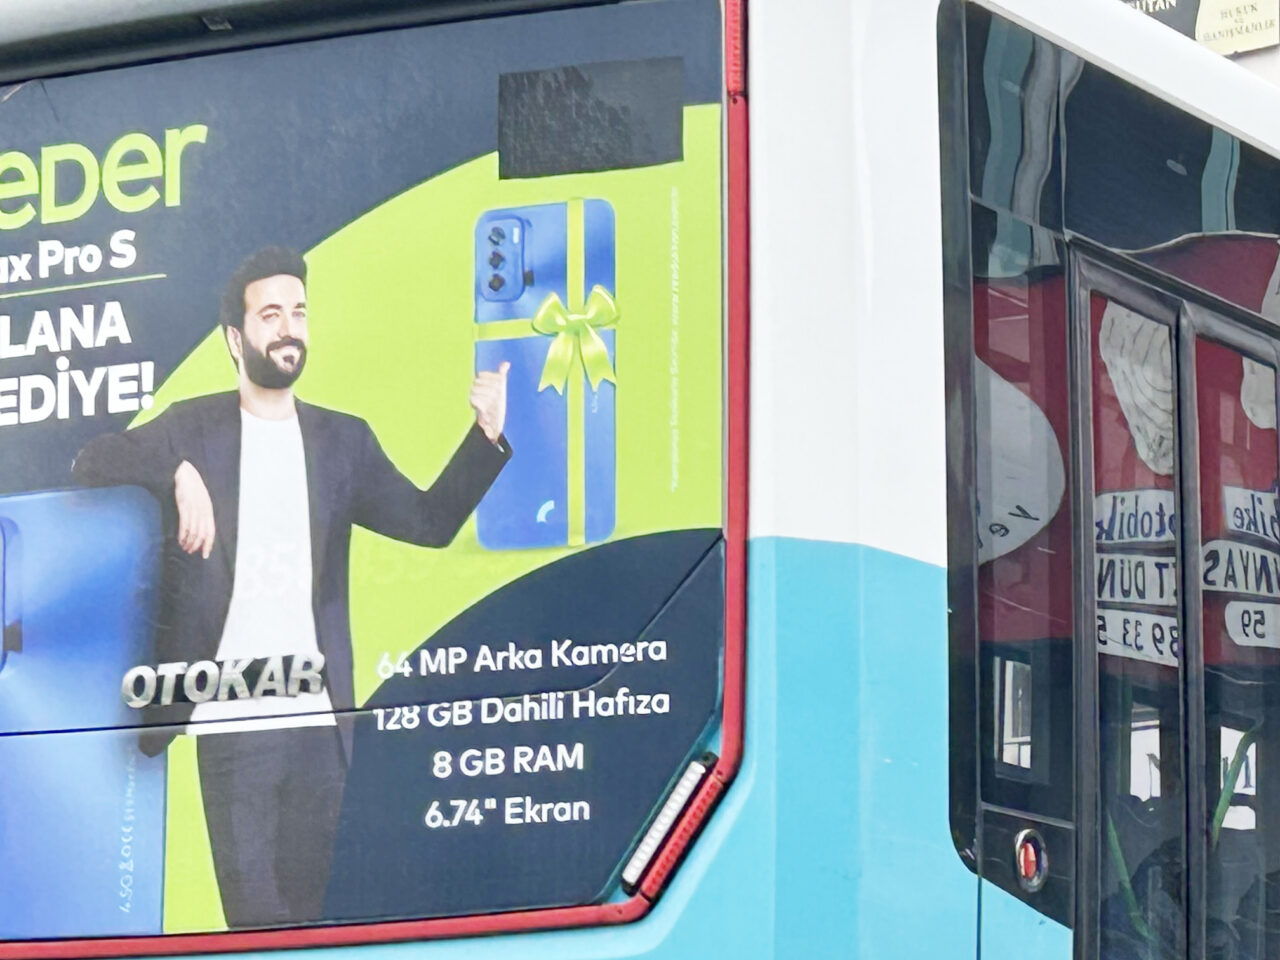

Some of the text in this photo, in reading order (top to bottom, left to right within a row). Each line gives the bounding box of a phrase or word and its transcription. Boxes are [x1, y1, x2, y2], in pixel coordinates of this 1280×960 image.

[38, 240, 103, 278] Pro
[110, 229, 137, 269] S
[0, 301, 132, 359] LANA
[376, 640, 668, 679] 64 MP Arka Kamera
[121, 653, 326, 708] OTOKAR
[373, 705, 420, 731] 128
[427, 700, 473, 727] GB
[481, 692, 564, 724] Dahili
[432, 743, 584, 779] 8 GB RAM
[504, 796, 591, 825] Ekran
